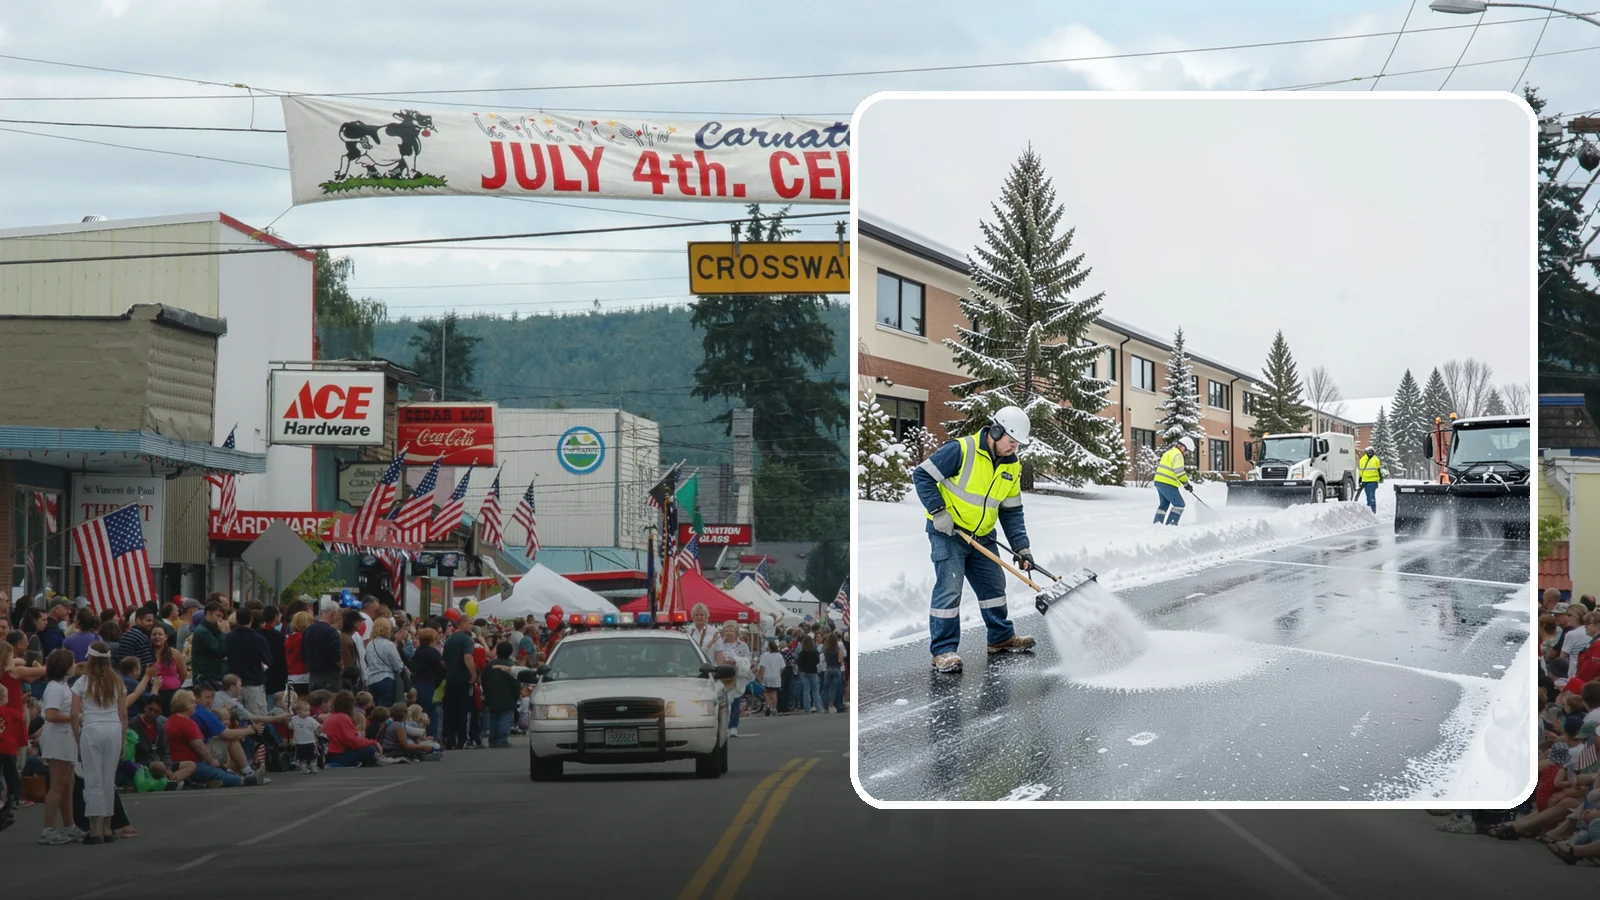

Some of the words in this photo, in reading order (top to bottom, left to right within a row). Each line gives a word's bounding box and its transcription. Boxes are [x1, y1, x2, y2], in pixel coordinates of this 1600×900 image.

[481, 141, 605, 192] JULY
[633, 151, 746, 198] 4th.
[697, 253, 850, 280] CROSSWA
[283, 380, 374, 420] ACE
[406, 409, 453, 422] CEDAR
[283, 421, 371, 437] Hardware
[416, 428, 477, 447] Coca-Cola
[353, 467, 385, 478] Simpl
[95, 485, 124, 495] Vincent
[126, 486, 136, 495] de
[137, 486, 155, 495] Paul
[349, 477, 378, 487] GRA
[80, 503, 154, 522] THT
[212, 516, 331, 536] HARDARE
[688, 526, 741, 535] CRNATION
[699, 535, 730, 543] GLASS
